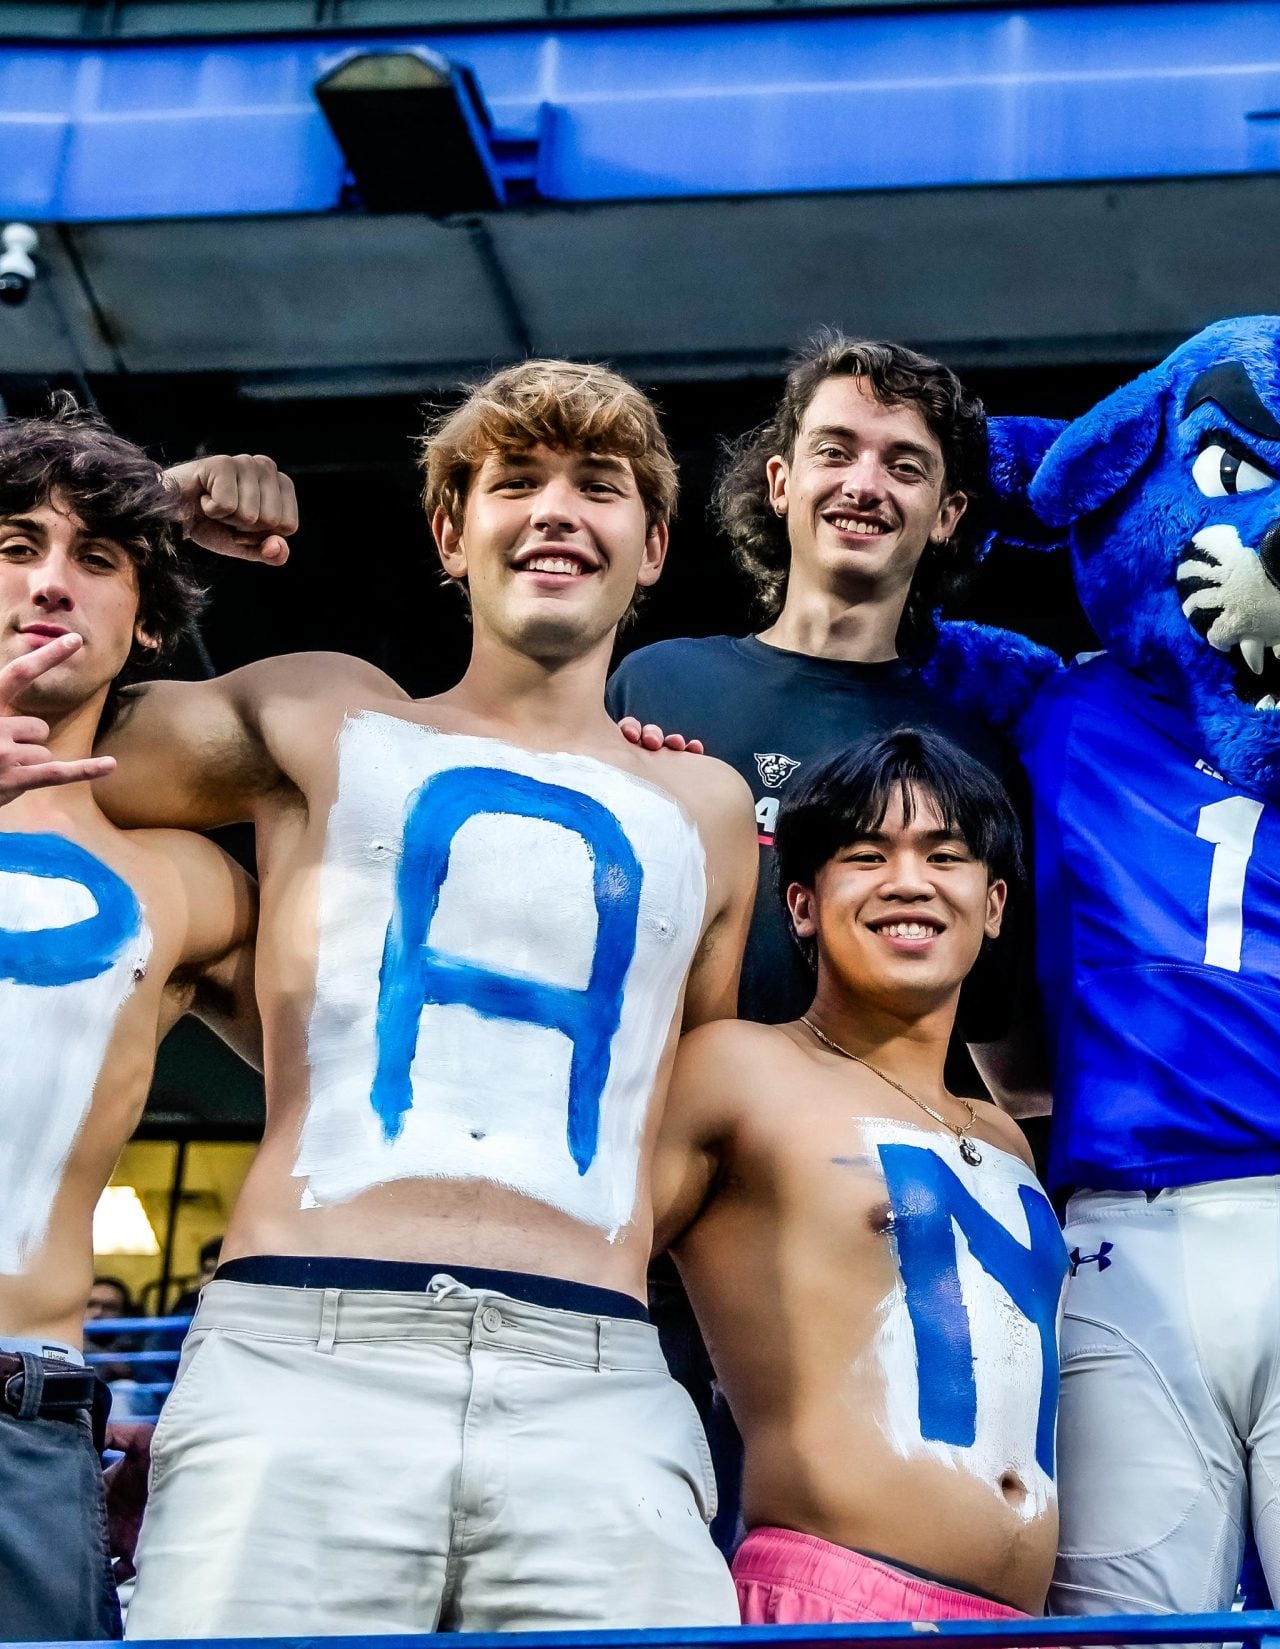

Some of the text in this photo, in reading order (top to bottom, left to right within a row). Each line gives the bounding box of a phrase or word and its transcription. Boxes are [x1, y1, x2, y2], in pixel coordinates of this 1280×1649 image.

[370, 766, 644, 1176] A
[1196, 795, 1265, 973] 1
[877, 1143, 1072, 1481] N
